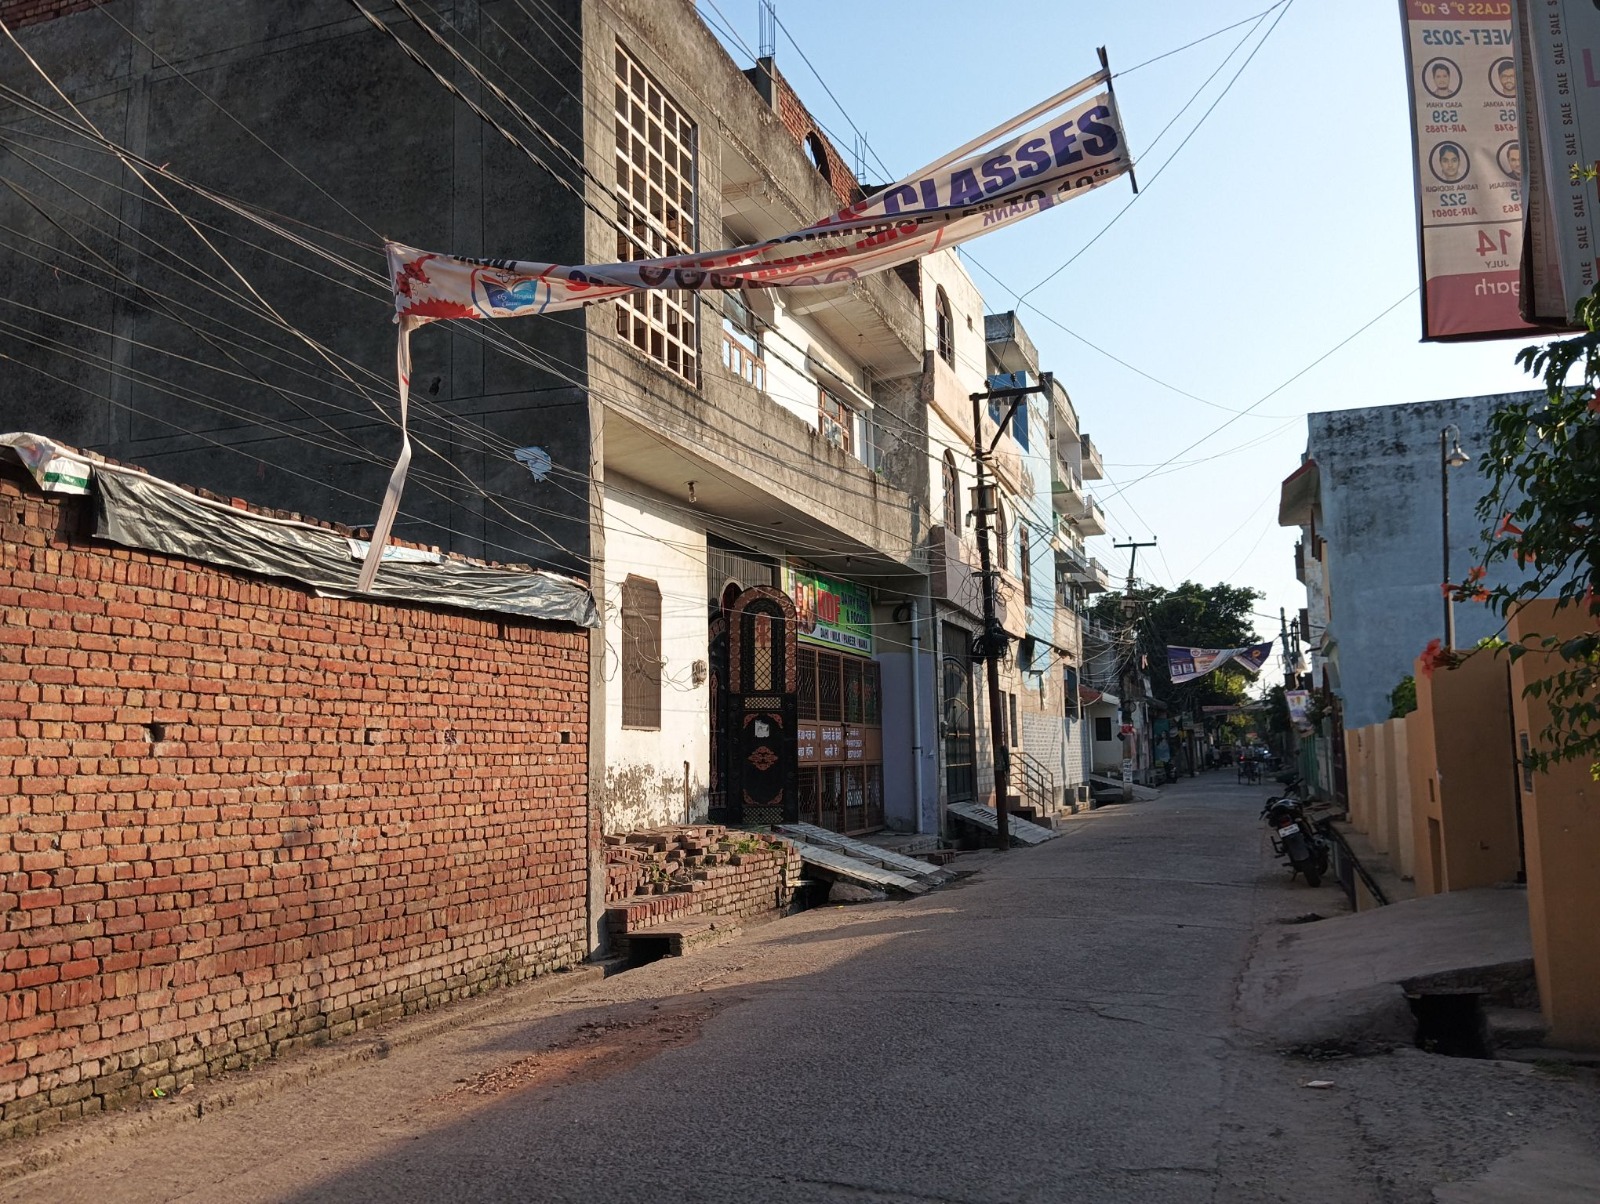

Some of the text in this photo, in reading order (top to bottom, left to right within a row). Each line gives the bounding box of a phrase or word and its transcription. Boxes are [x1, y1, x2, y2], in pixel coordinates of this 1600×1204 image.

[1549, 12, 1561, 35] SALE
[1553, 43, 1565, 65] SALE
[1557, 72, 1569, 95] SALE
[1561, 102, 1573, 125] SALE
[1565, 133, 1577, 156] SALE
[883, 105, 1118, 214] CLASSES
[1572, 194, 1585, 218] SALE
[1576, 225, 1589, 250] SALE
[1581, 261, 1593, 286] SALE
[817, 589, 840, 625] KDF
